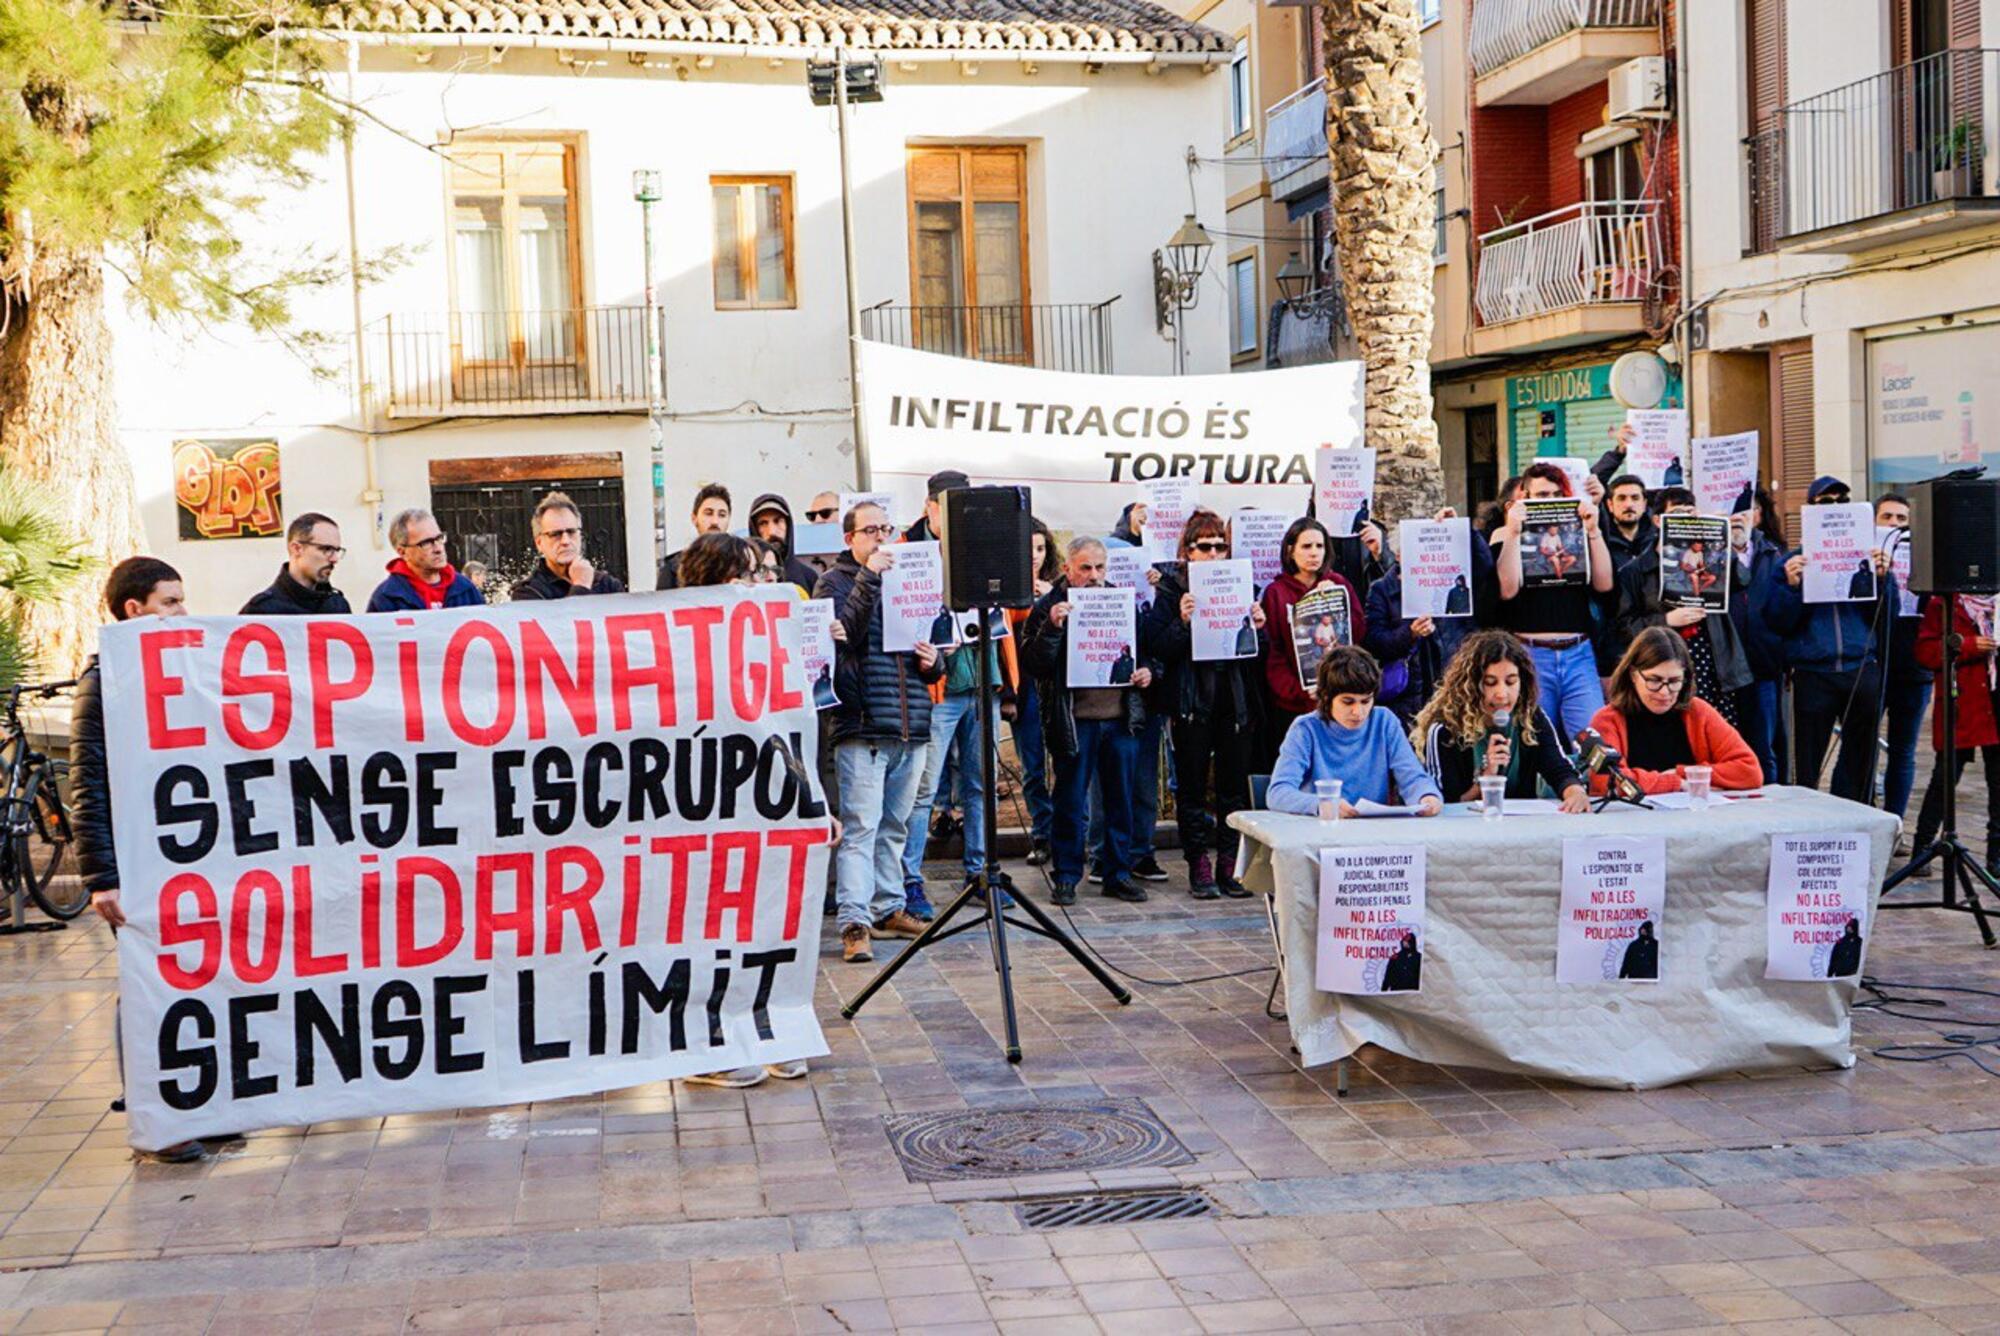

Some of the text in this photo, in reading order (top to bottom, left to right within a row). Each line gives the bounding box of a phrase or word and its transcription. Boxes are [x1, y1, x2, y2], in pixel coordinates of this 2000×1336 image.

[889, 395, 1251, 440] INFILTRACIÓ ÉS
[1104, 451, 1314, 484] TORTURA
[902, 581, 912, 592] NO
[921, 579, 934, 590] LES
[1088, 629, 1098, 638] NO
[1105, 628, 1117, 638] LES
[154, 725, 827, 865] SENSE ESCRÚPOL
[1785, 841, 1857, 851] TOT EL SUPORT A LES
[1335, 855, 1413, 867] NO A LA COMPLICITAT
[1598, 850, 1627, 861] CONTRA
[1797, 855, 1844, 864] COMPANYES I
[1344, 869, 1405, 880] JUDICIAL, EXIGIM
[1583, 863, 1644, 875] L'ESPIONATGE DE
[1338, 882, 1409, 893] RESPONSABILITATS
[1599, 877, 1628, 888] L'ESTAT
[1801, 880, 1837, 890] AFECTATS
[1379, 897, 1382, 905] I
[1383, 895, 1411, 905] PENALS
[1591, 890, 1635, 904] NO A LES
[1796, 894, 1842, 907] NO A LES
[1351, 909, 1396, 923] NO A LES
[1573, 908, 1649, 921] INFILTRACIONS
[1782, 912, 1854, 925] INFILTRACIONS
[1333, 926, 1411, 941] INFILTRACIONS
[1585, 926, 1636, 939] POLICIALS
[1793, 930, 1842, 944] POLICIALS
[1345, 945, 1398, 959] POLICIALS
[158, 972, 488, 1112] SENSE
